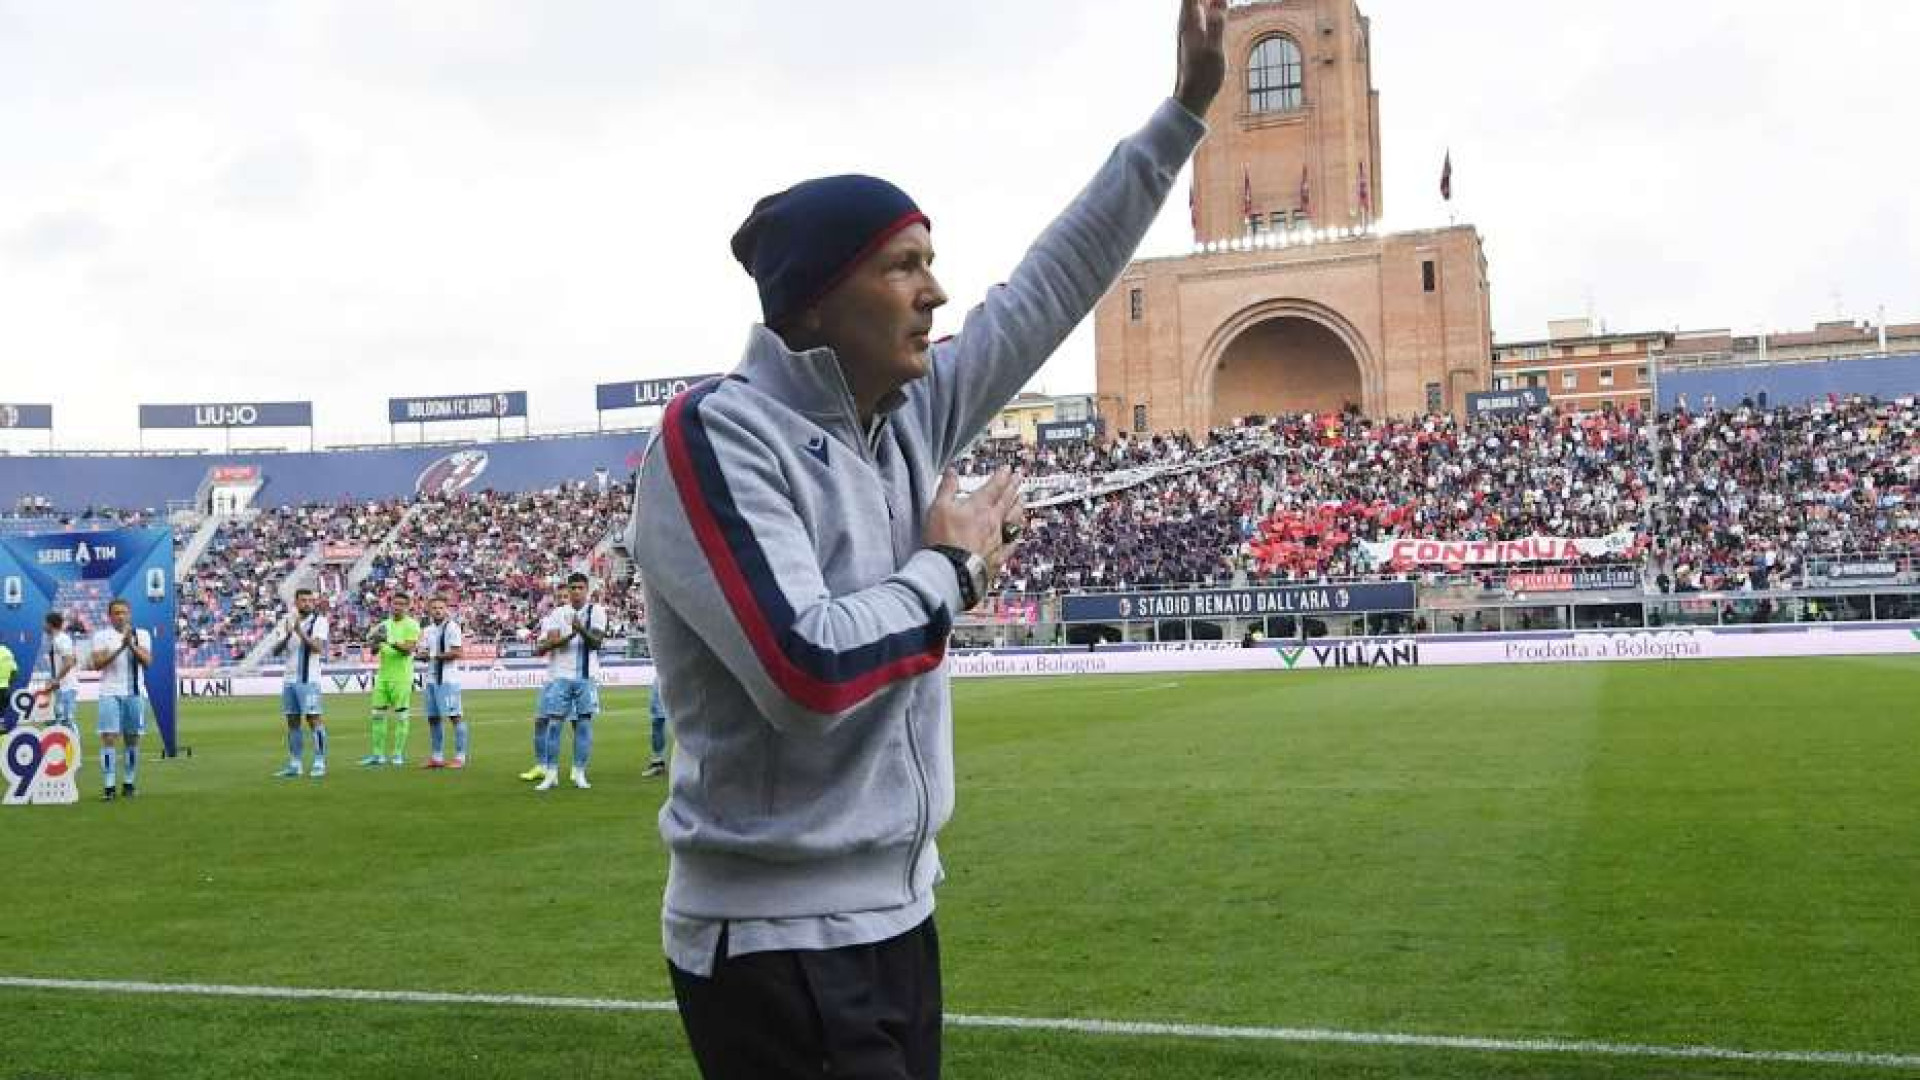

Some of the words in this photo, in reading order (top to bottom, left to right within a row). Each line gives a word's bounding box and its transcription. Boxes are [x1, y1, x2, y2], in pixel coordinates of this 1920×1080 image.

[38, 548, 72, 563] SERIE
[76, 542, 91, 565] A
[94, 547, 116, 560] TIM
[1392, 539, 1580, 563] CONTINUA
[1138, 596, 1188, 616] STADIO
[1195, 592, 1250, 614] RENATO
[1257, 586, 1330, 612] DALL'ARA
[1313, 644, 1419, 667] VILLANI
[1506, 640, 1589, 659] Prodotta
[1616, 637, 1702, 660] Bologna
[948, 654, 1017, 674] Prodotta
[1036, 655, 1106, 674] Bologna
[7, 732, 74, 798] 90
